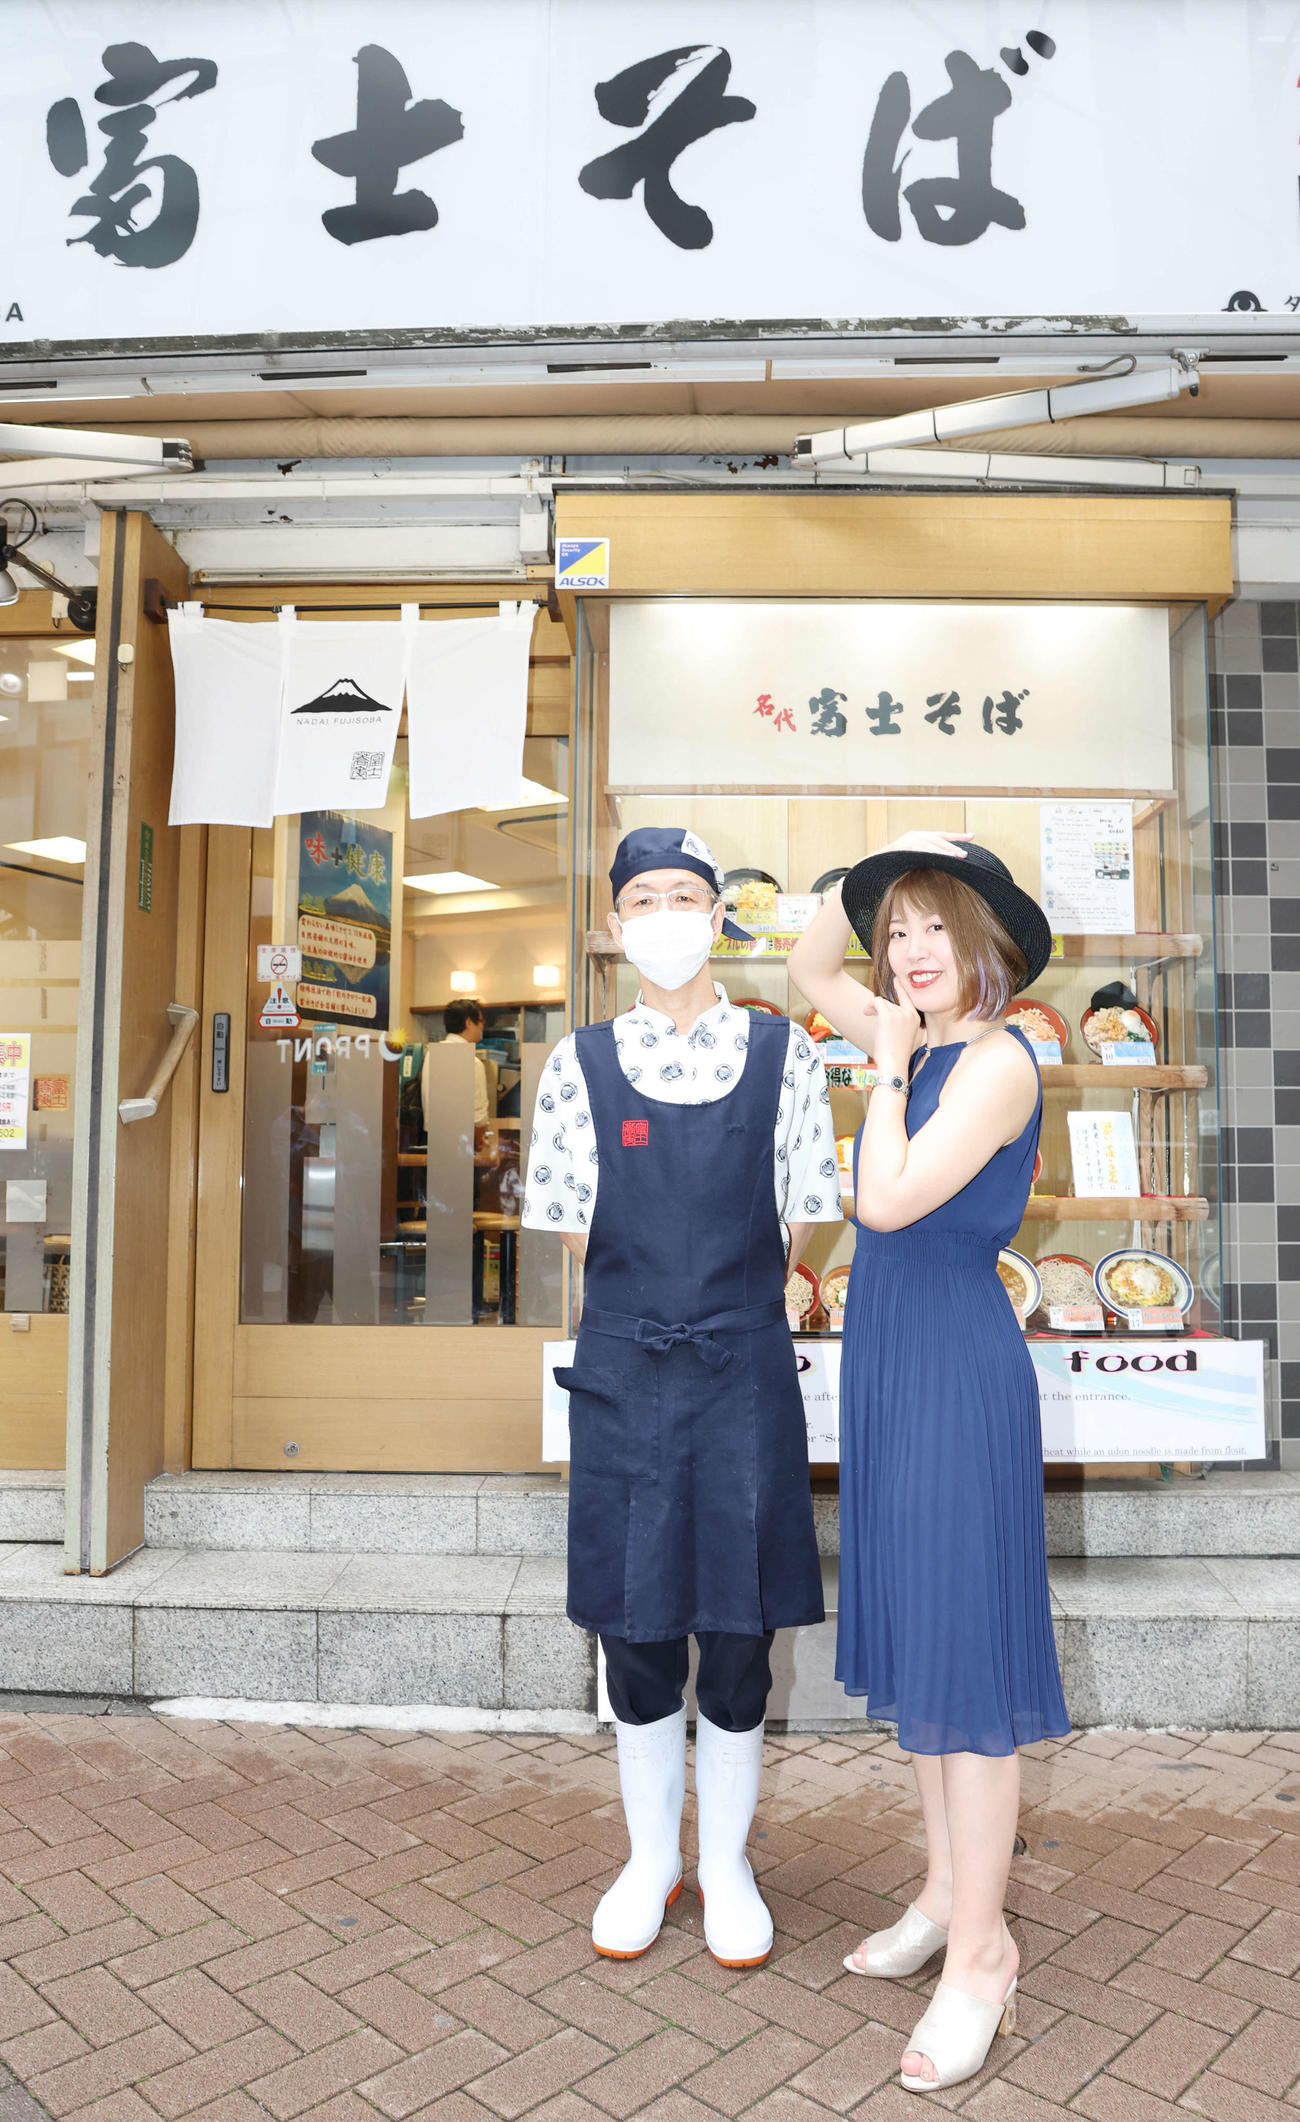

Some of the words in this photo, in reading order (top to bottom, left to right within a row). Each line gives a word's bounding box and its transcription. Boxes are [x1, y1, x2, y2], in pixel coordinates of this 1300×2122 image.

[47, 30, 1056, 270] 富士そば
[559, 577, 606, 586] ALSOK
[752, 694, 797, 732] 名代
[808, 687, 1030, 738] 富士そば
[297, 718, 329, 726] NADAI
[333, 716, 382, 725] FUJISOBA
[1062, 1350, 1198, 1373] food
[814, 1391, 838, 1401] afte
[1052, 1391, 1072, 1401] the
[1075, 1392, 1132, 1401] entrance.
[1044, 1447, 1063, 1457] heat
[1067, 1447, 1091, 1457] while
[1094, 1449, 1105, 1457] an
[1107, 1447, 1130, 1456] udon
[1132, 1446, 1162, 1456] noodle
[1175, 1446, 1198, 1455] made
[1201, 1445, 1223, 1455] from
